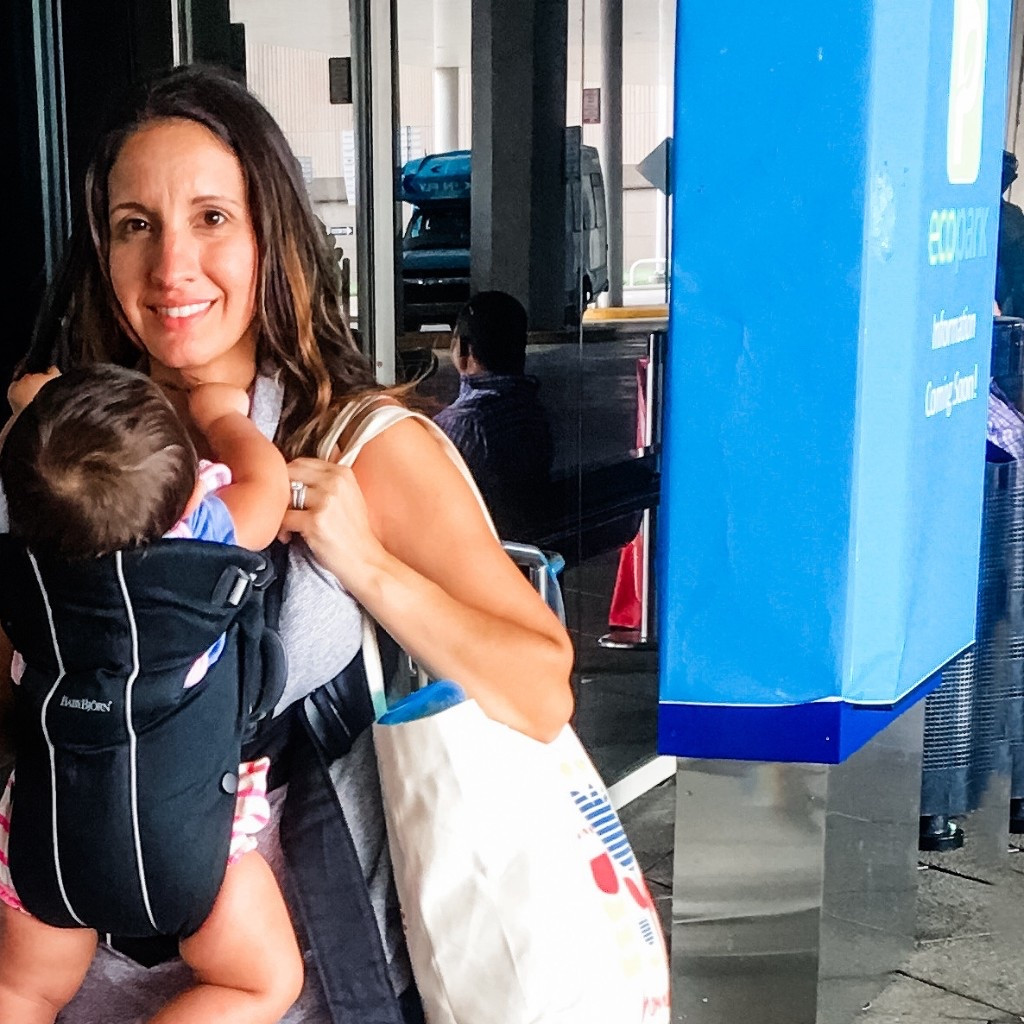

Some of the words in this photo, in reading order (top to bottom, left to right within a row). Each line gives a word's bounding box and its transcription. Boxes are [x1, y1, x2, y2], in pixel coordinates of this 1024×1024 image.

[927, 207, 989, 275] ecopark
[931, 305, 977, 351] Information
[924, 375, 953, 418] Coming
[952, 363, 979, 406] Soon!
